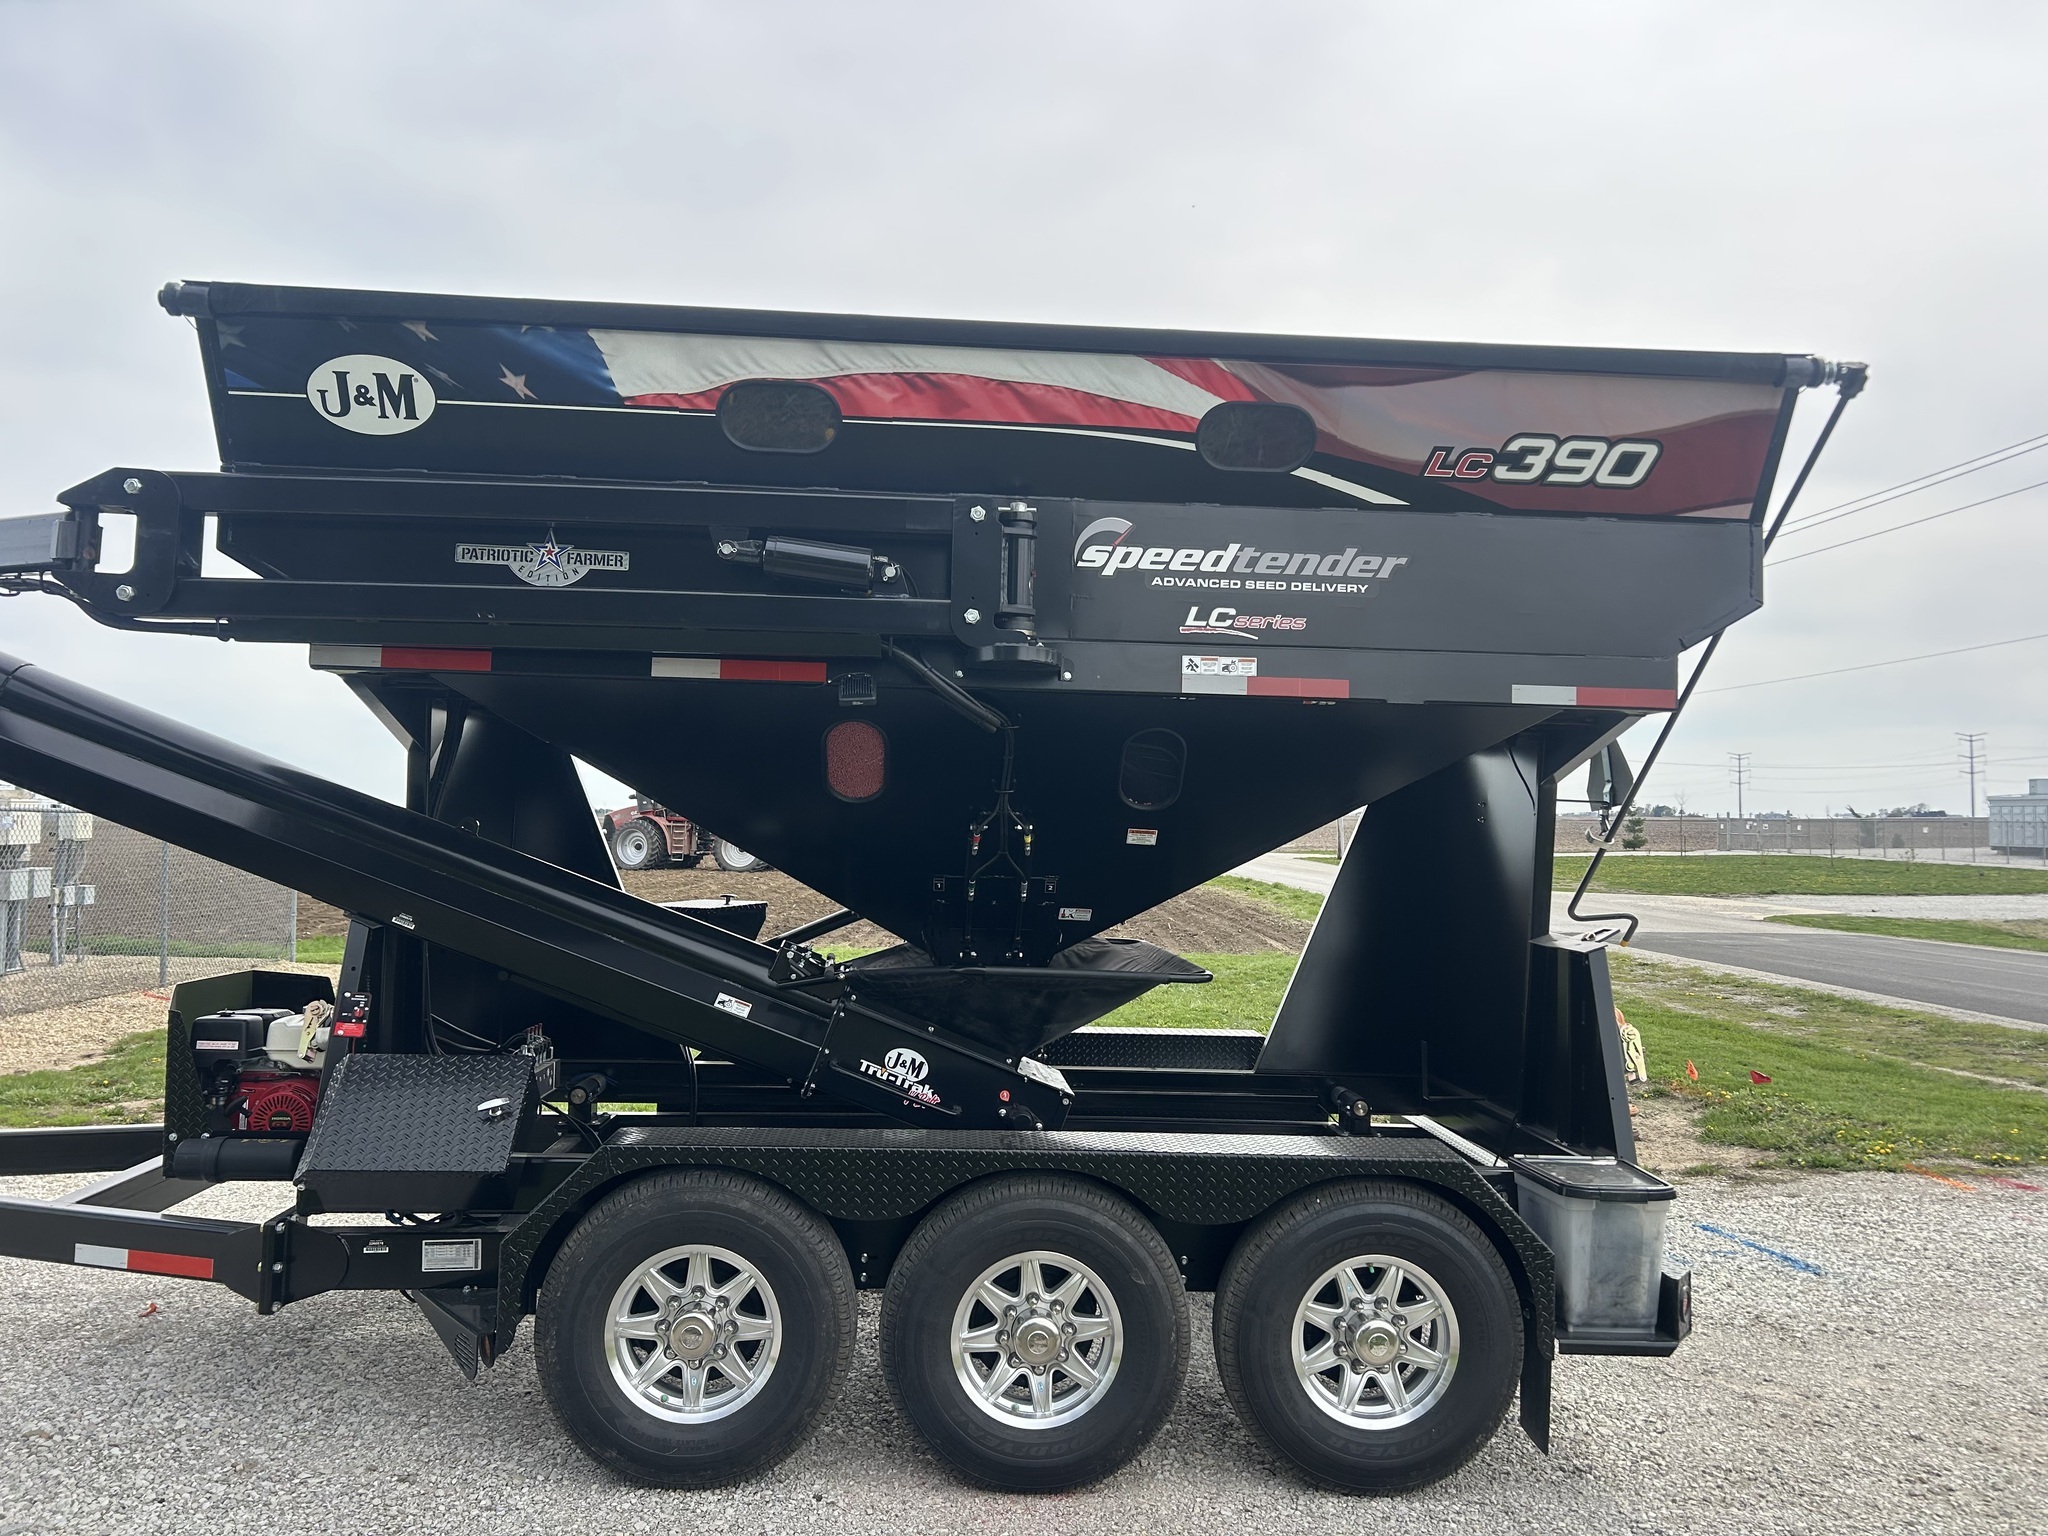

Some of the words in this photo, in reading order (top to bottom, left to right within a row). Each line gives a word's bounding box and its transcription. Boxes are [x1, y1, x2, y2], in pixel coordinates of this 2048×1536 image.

[316, 370, 420, 420] J&M
[461, 547, 534, 563] PATRIOTIC
[566, 552, 624, 568] FARMER
[517, 566, 580, 582] EDITION
[1151, 577, 1241, 589] ADVANCED
[1245, 580, 1287, 591] SEED
[1290, 582, 1369, 594] DELIVERY
[859, 1058, 935, 1098] Tru-Trak
[886, 1051, 926, 1080] J&M
